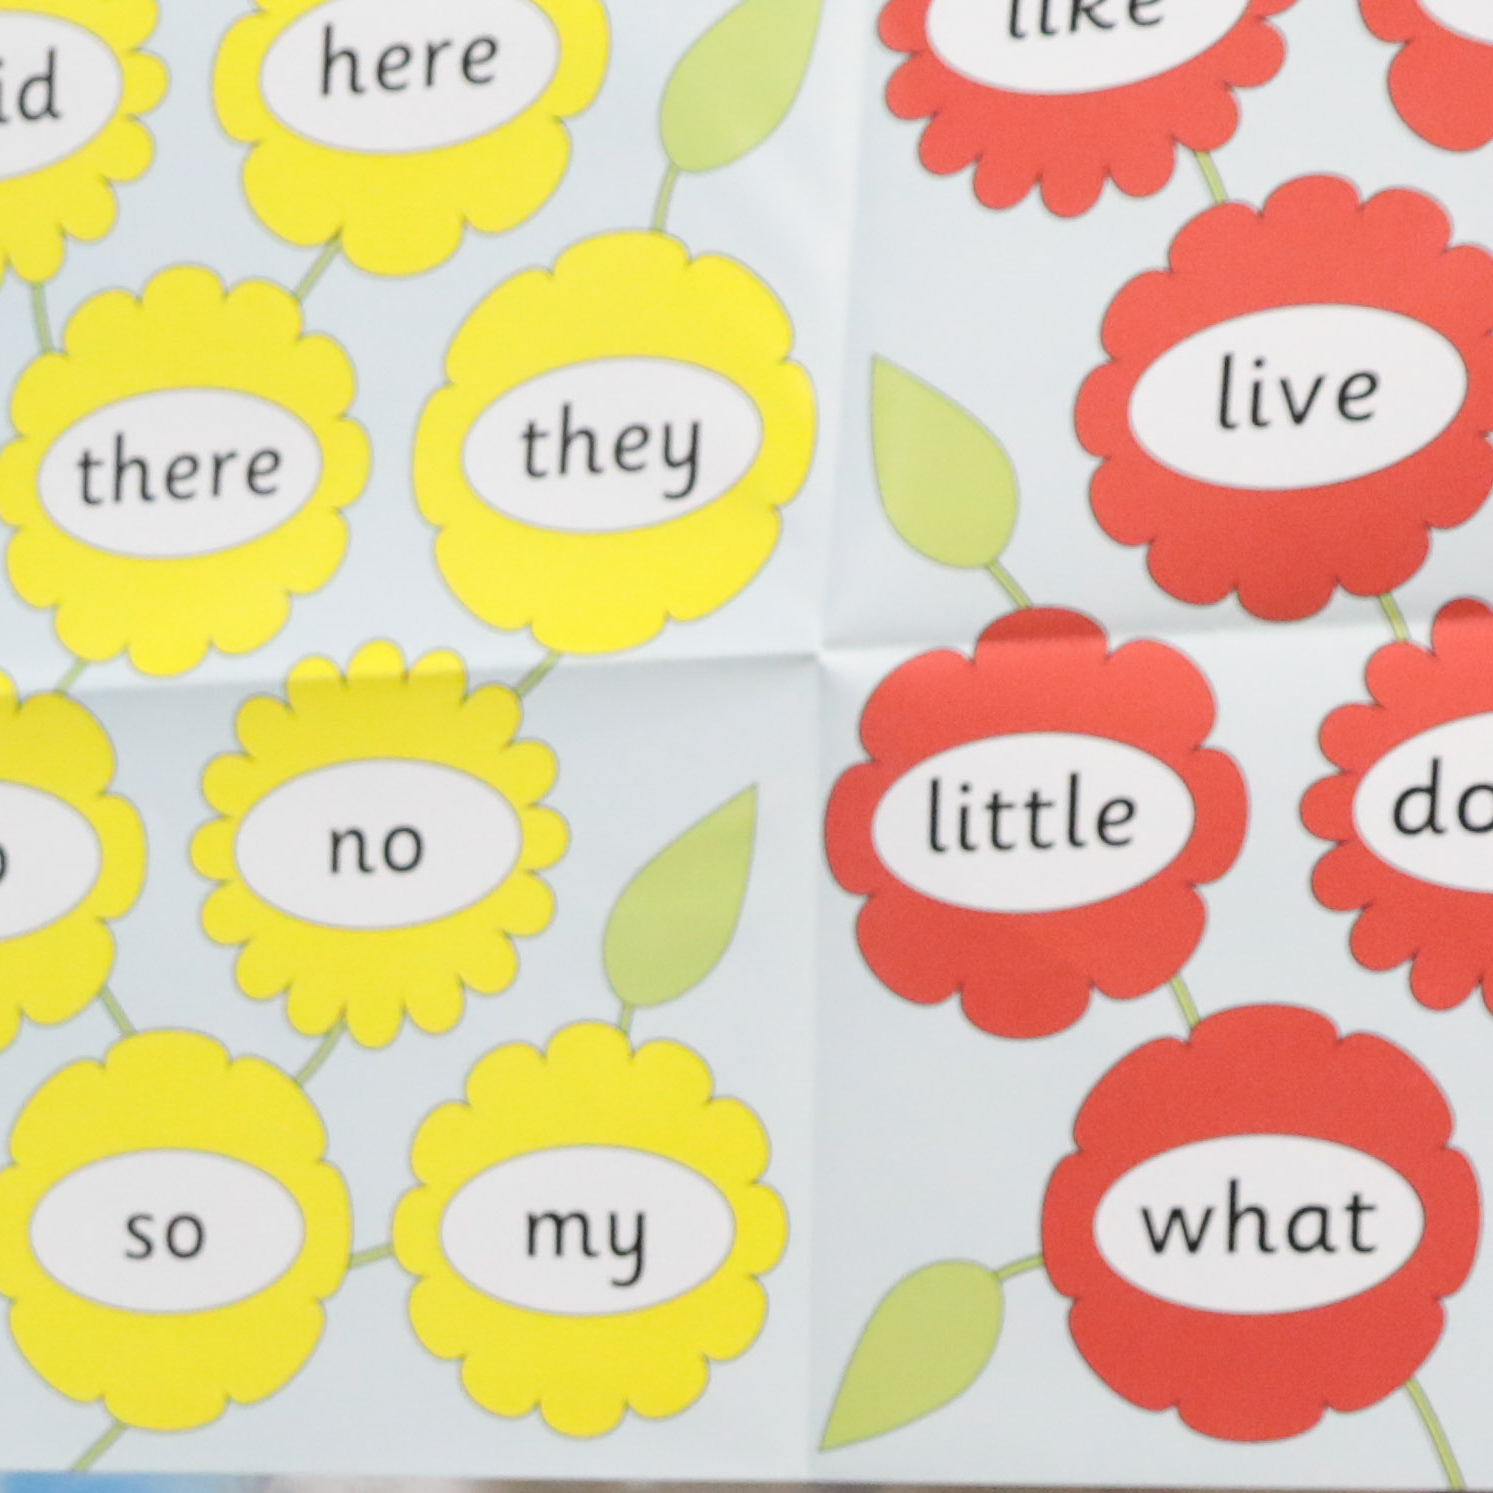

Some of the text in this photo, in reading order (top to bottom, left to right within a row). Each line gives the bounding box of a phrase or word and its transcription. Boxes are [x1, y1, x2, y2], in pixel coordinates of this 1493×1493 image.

[320, 23, 499, 97] here
[1217, 353, 1380, 431] live
[76, 431, 283, 507] there
[520, 402, 701, 502] they
[928, 771, 1137, 854] little
[1392, 757, 1493, 837] do
[329, 824, 425, 875] no
[125, 1212, 207, 1261] so
[526, 1210, 646, 1288] my
[1140, 1178, 1377, 1255] what
